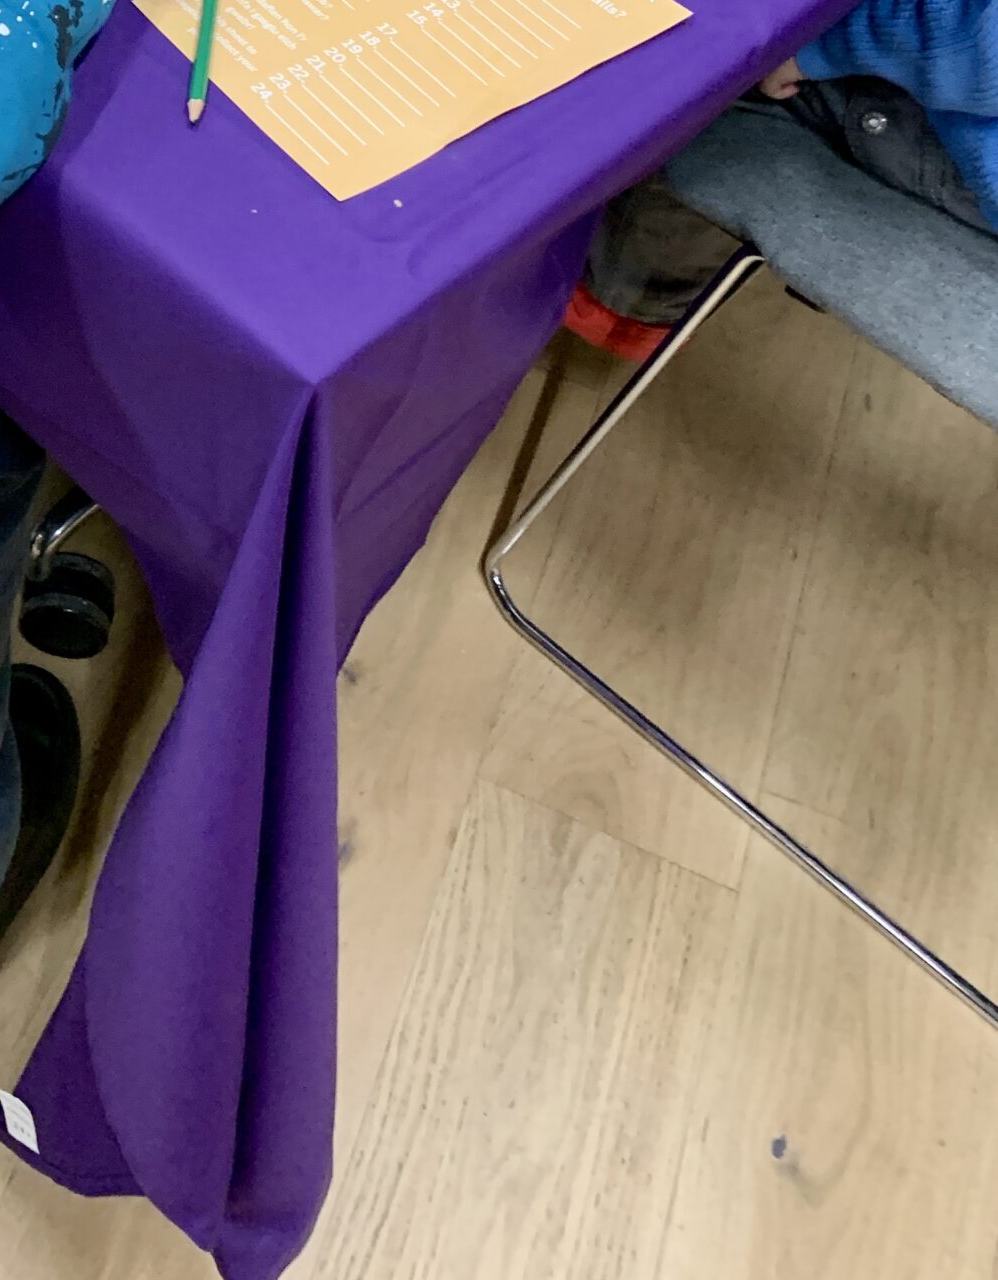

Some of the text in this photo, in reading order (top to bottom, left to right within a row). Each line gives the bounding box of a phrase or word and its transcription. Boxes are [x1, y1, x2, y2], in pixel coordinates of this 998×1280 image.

[405, 9, 428, 29] 15.
[422, 1, 445, 22] 14.
[358, 30, 381, 49] 18.
[375, 22, 399, 40] 17.
[322, 46, 347, 67] 20.
[341, 38, 364, 58] 19.
[287, 63, 310, 83] 22.
[305, 54, 327, 74] 21.
[249, 82, 274, 103] 24.
[268, 72, 292, 94] 23.
